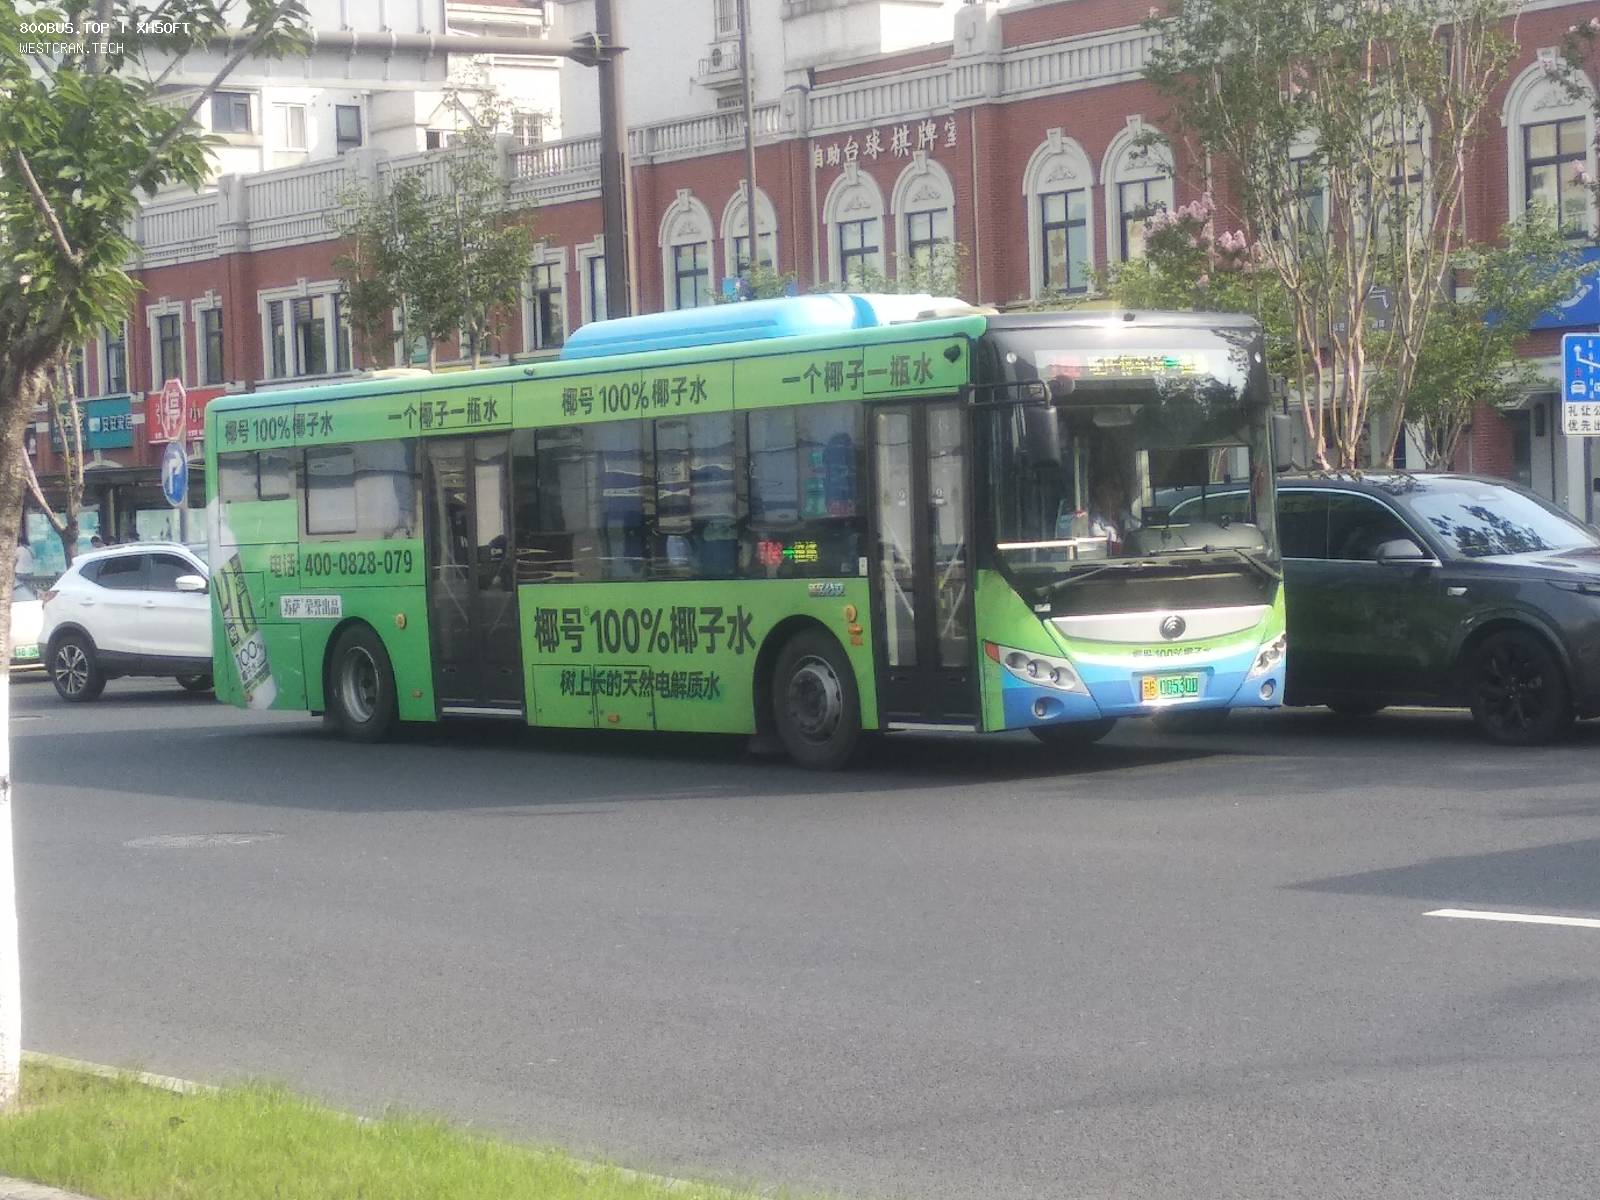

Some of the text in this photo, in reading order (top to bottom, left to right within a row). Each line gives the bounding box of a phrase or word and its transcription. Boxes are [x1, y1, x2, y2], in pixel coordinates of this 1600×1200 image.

[814, 117, 958, 169] 自助台球棋牌室
[782, 351, 934, 395] 一个椰子一瓶水
[164, 390, 182, 431] 停
[388, 396, 499, 430] 一个椰子一瓶水
[305, 549, 413, 577] 400-0828-079
[560, 669, 721, 700] 树上长的天然电解质水
